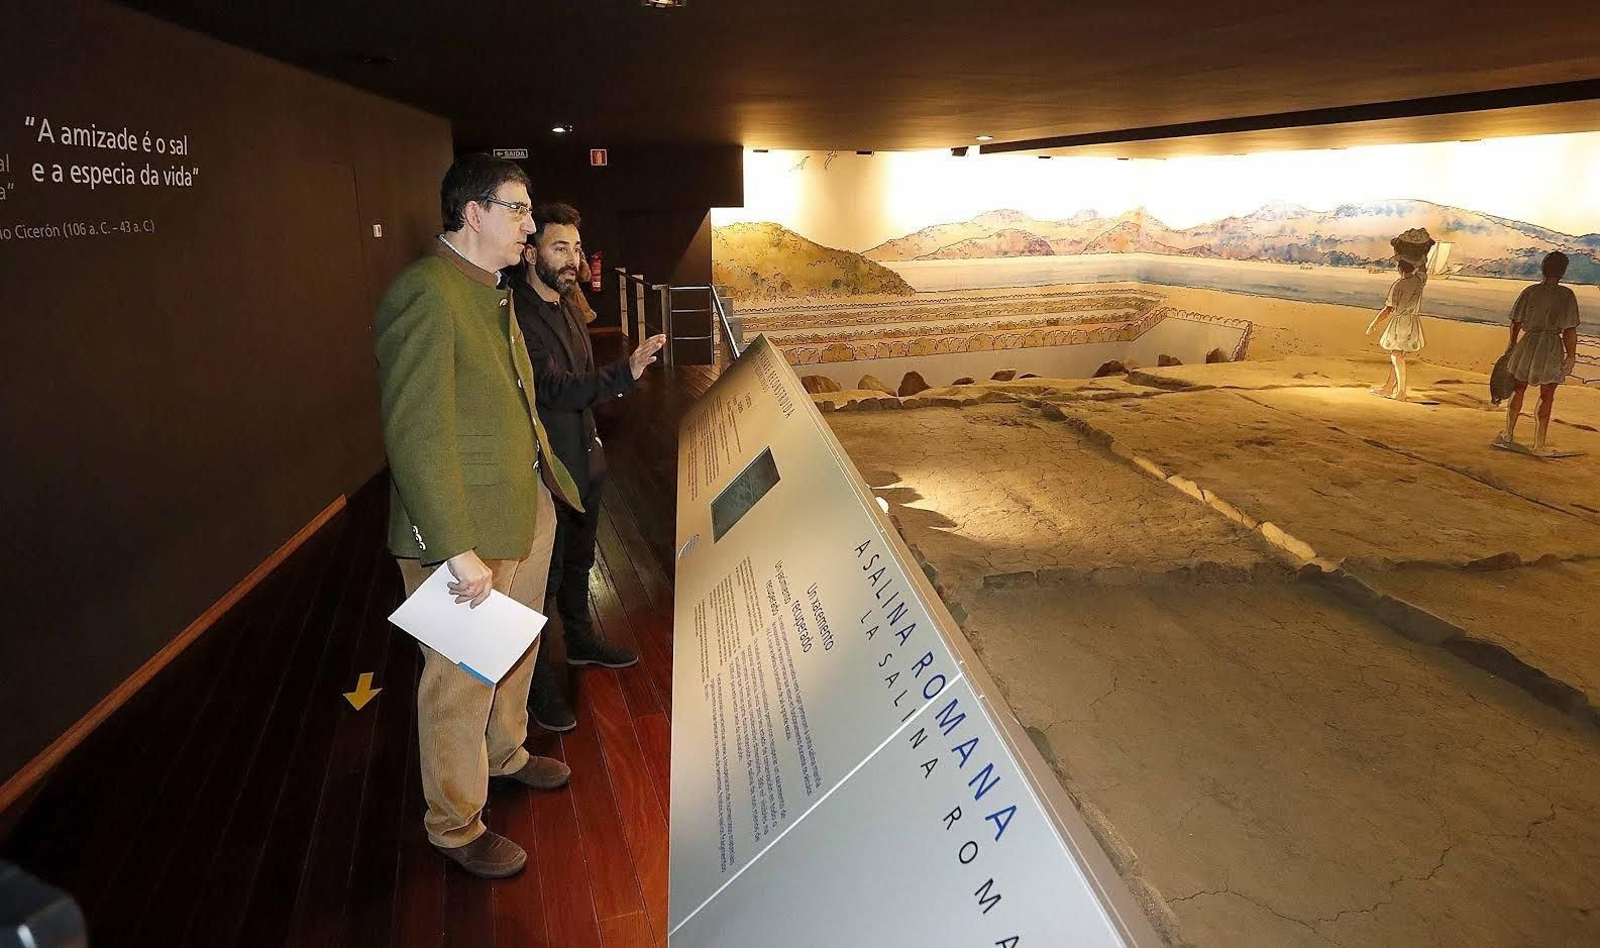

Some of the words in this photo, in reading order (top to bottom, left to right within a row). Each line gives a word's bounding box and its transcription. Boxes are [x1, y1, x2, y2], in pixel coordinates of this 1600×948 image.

[61, 124, 138, 151] amizade
[142, 131, 151, 152] é
[156, 138, 165, 154] o
[170, 135, 188, 156] sal
[32, 162, 44, 182] e
[52, 163, 63, 183] a
[70, 162, 135, 190] especia
[140, 163, 159, 186] da
[15, 223, 60, 239] Cicerón
[63, 222, 86, 238] (106
[120, 220, 131, 233] 43
[807, 581, 818, 601] Un
[791, 600, 814, 653] recuperado
[811, 598, 834, 651] xacemento
[860, 610, 879, 640] LA
[879, 653, 939, 779] SALINA
[911, 651, 1017, 841] ROMANA
